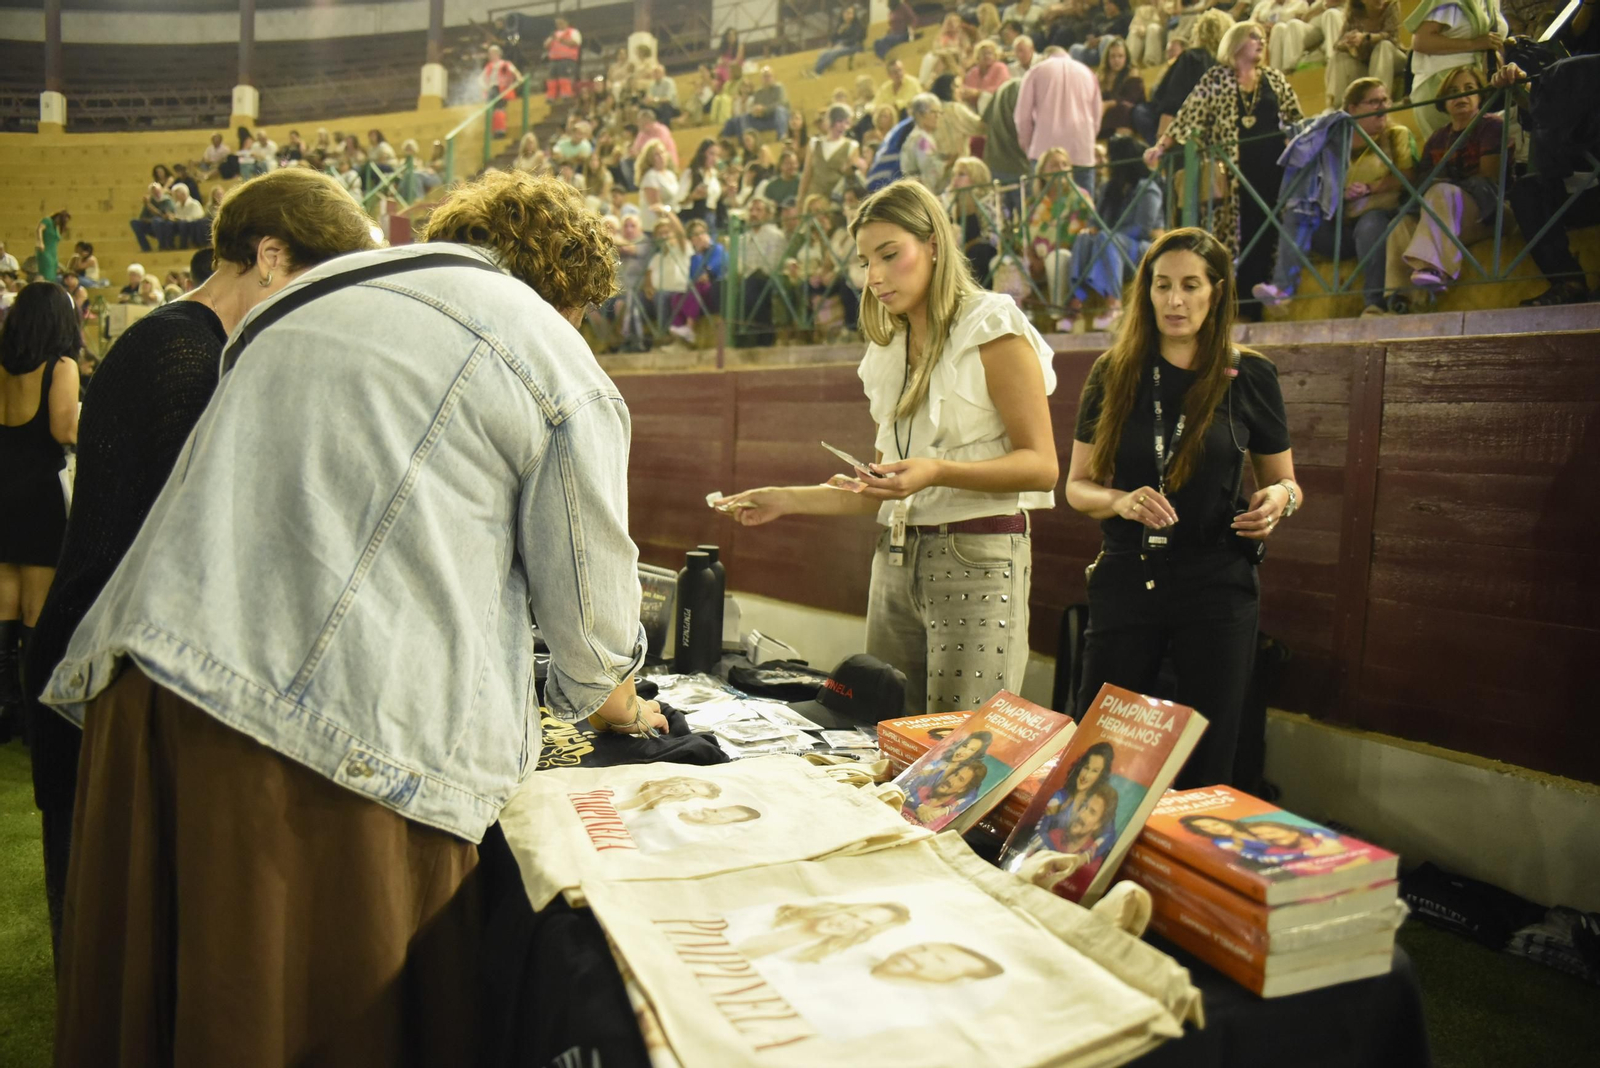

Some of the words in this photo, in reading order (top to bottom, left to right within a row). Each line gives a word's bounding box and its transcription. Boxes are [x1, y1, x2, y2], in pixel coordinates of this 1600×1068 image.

[892, 713, 972, 727] PIMPINELA
[984, 711, 1040, 743] HERMANOS
[991, 698, 1056, 734] PIMPINELA
[1099, 694, 1175, 733] PIMPINELA
[1096, 714, 1163, 747] HERMANOS
